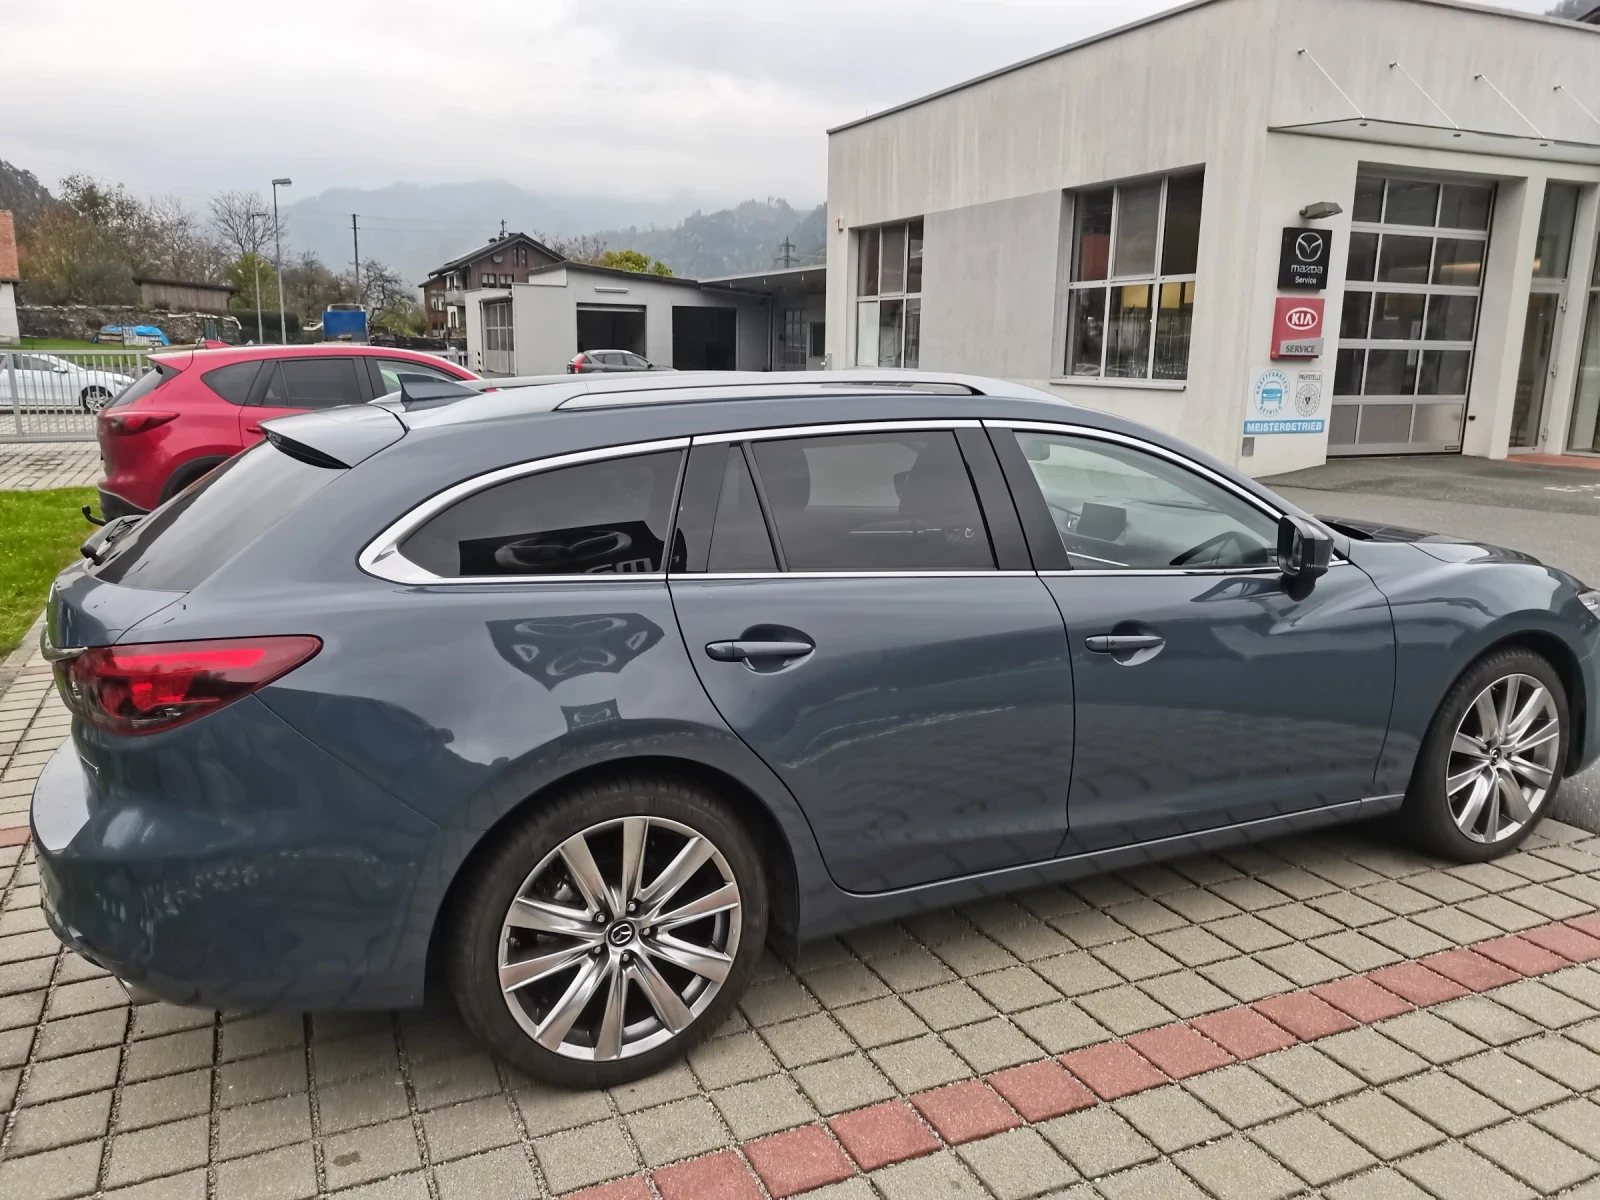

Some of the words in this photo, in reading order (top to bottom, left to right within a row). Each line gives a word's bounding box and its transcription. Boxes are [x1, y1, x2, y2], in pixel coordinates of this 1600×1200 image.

[1291, 264, 1323, 274] mazda
[1295, 276, 1317, 284] Service
[1291, 313, 1313, 325] KIA
[1286, 345, 1316, 353] SERVICE
[1247, 421, 1322, 432] MEISTERBETRIEB
